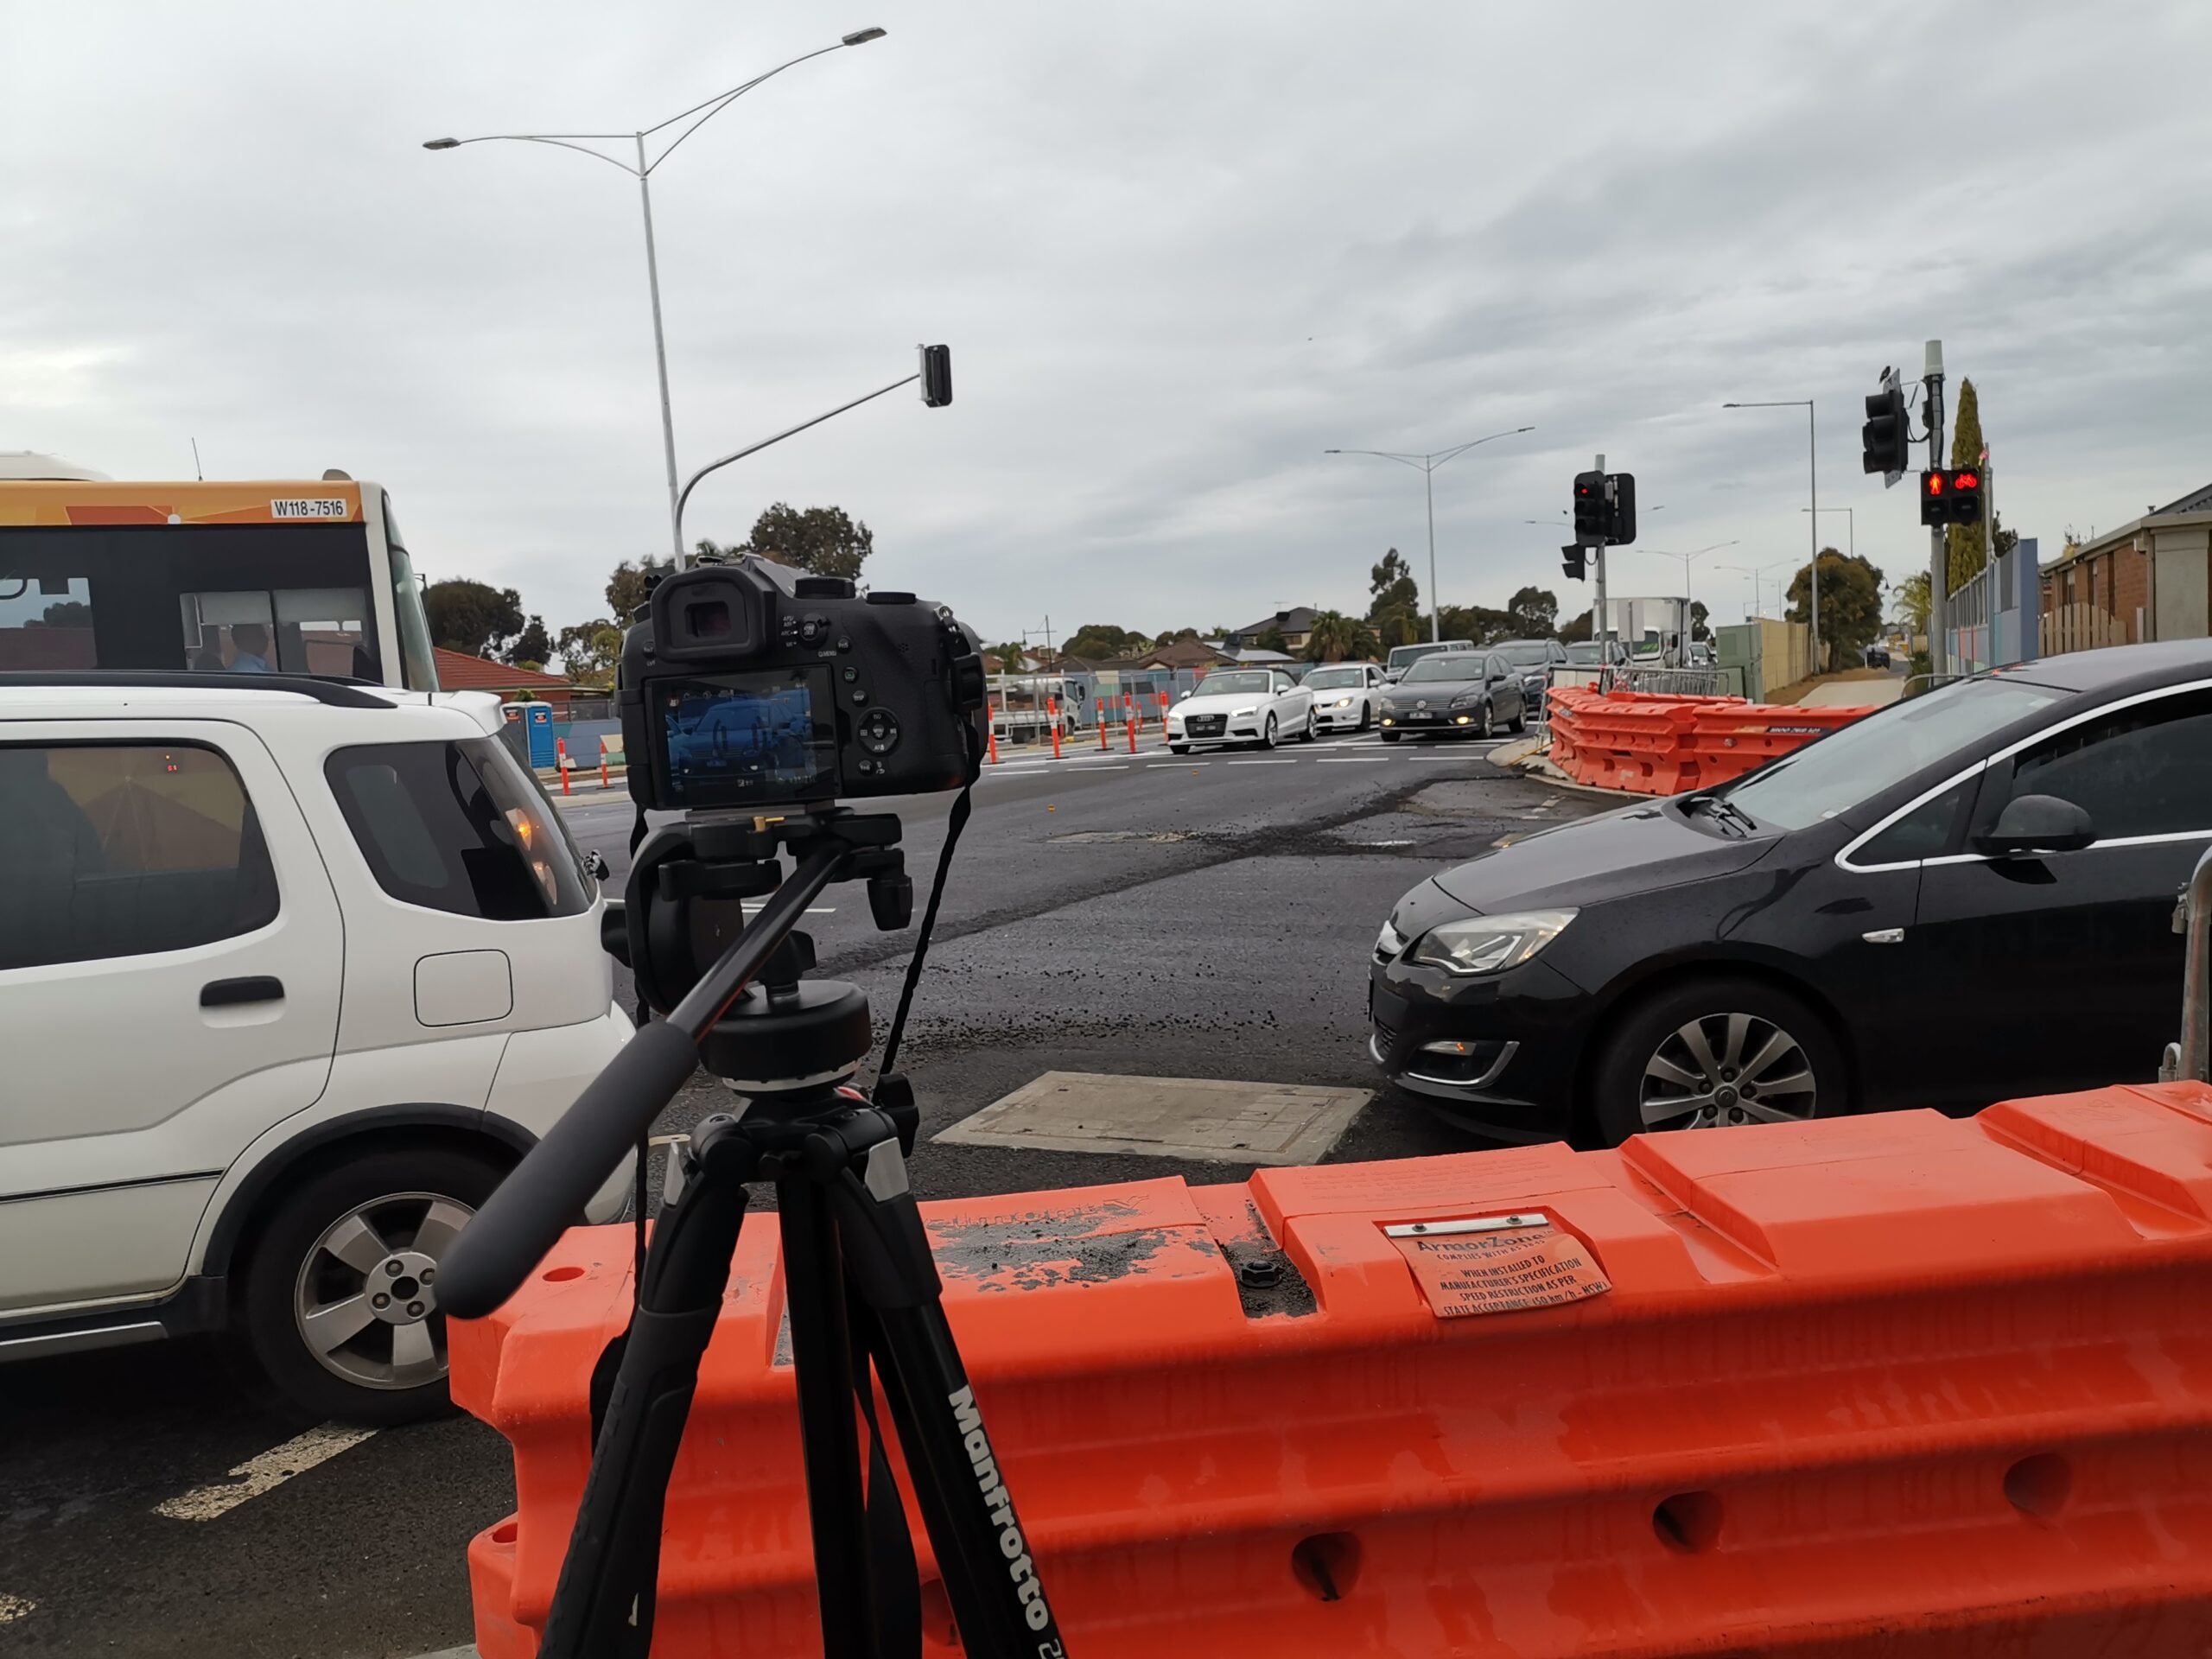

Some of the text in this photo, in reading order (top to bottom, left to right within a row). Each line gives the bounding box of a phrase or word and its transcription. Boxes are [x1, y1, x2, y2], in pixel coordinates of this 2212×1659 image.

[274, 500, 344, 516] W118-7516
[1482, 1249, 1509, 1258] WITH
[1440, 1257, 1582, 1291] MANUFACTURER'S SPECIFICATION
[1460, 1255, 1545, 1278] WHEN INSTALLED TO
[1459, 1274, 1577, 1301] SPEED RESTRICTION AS PER
[1444, 1305, 1471, 1315] STATE
[948, 1384, 1049, 1631] Manfrotto
